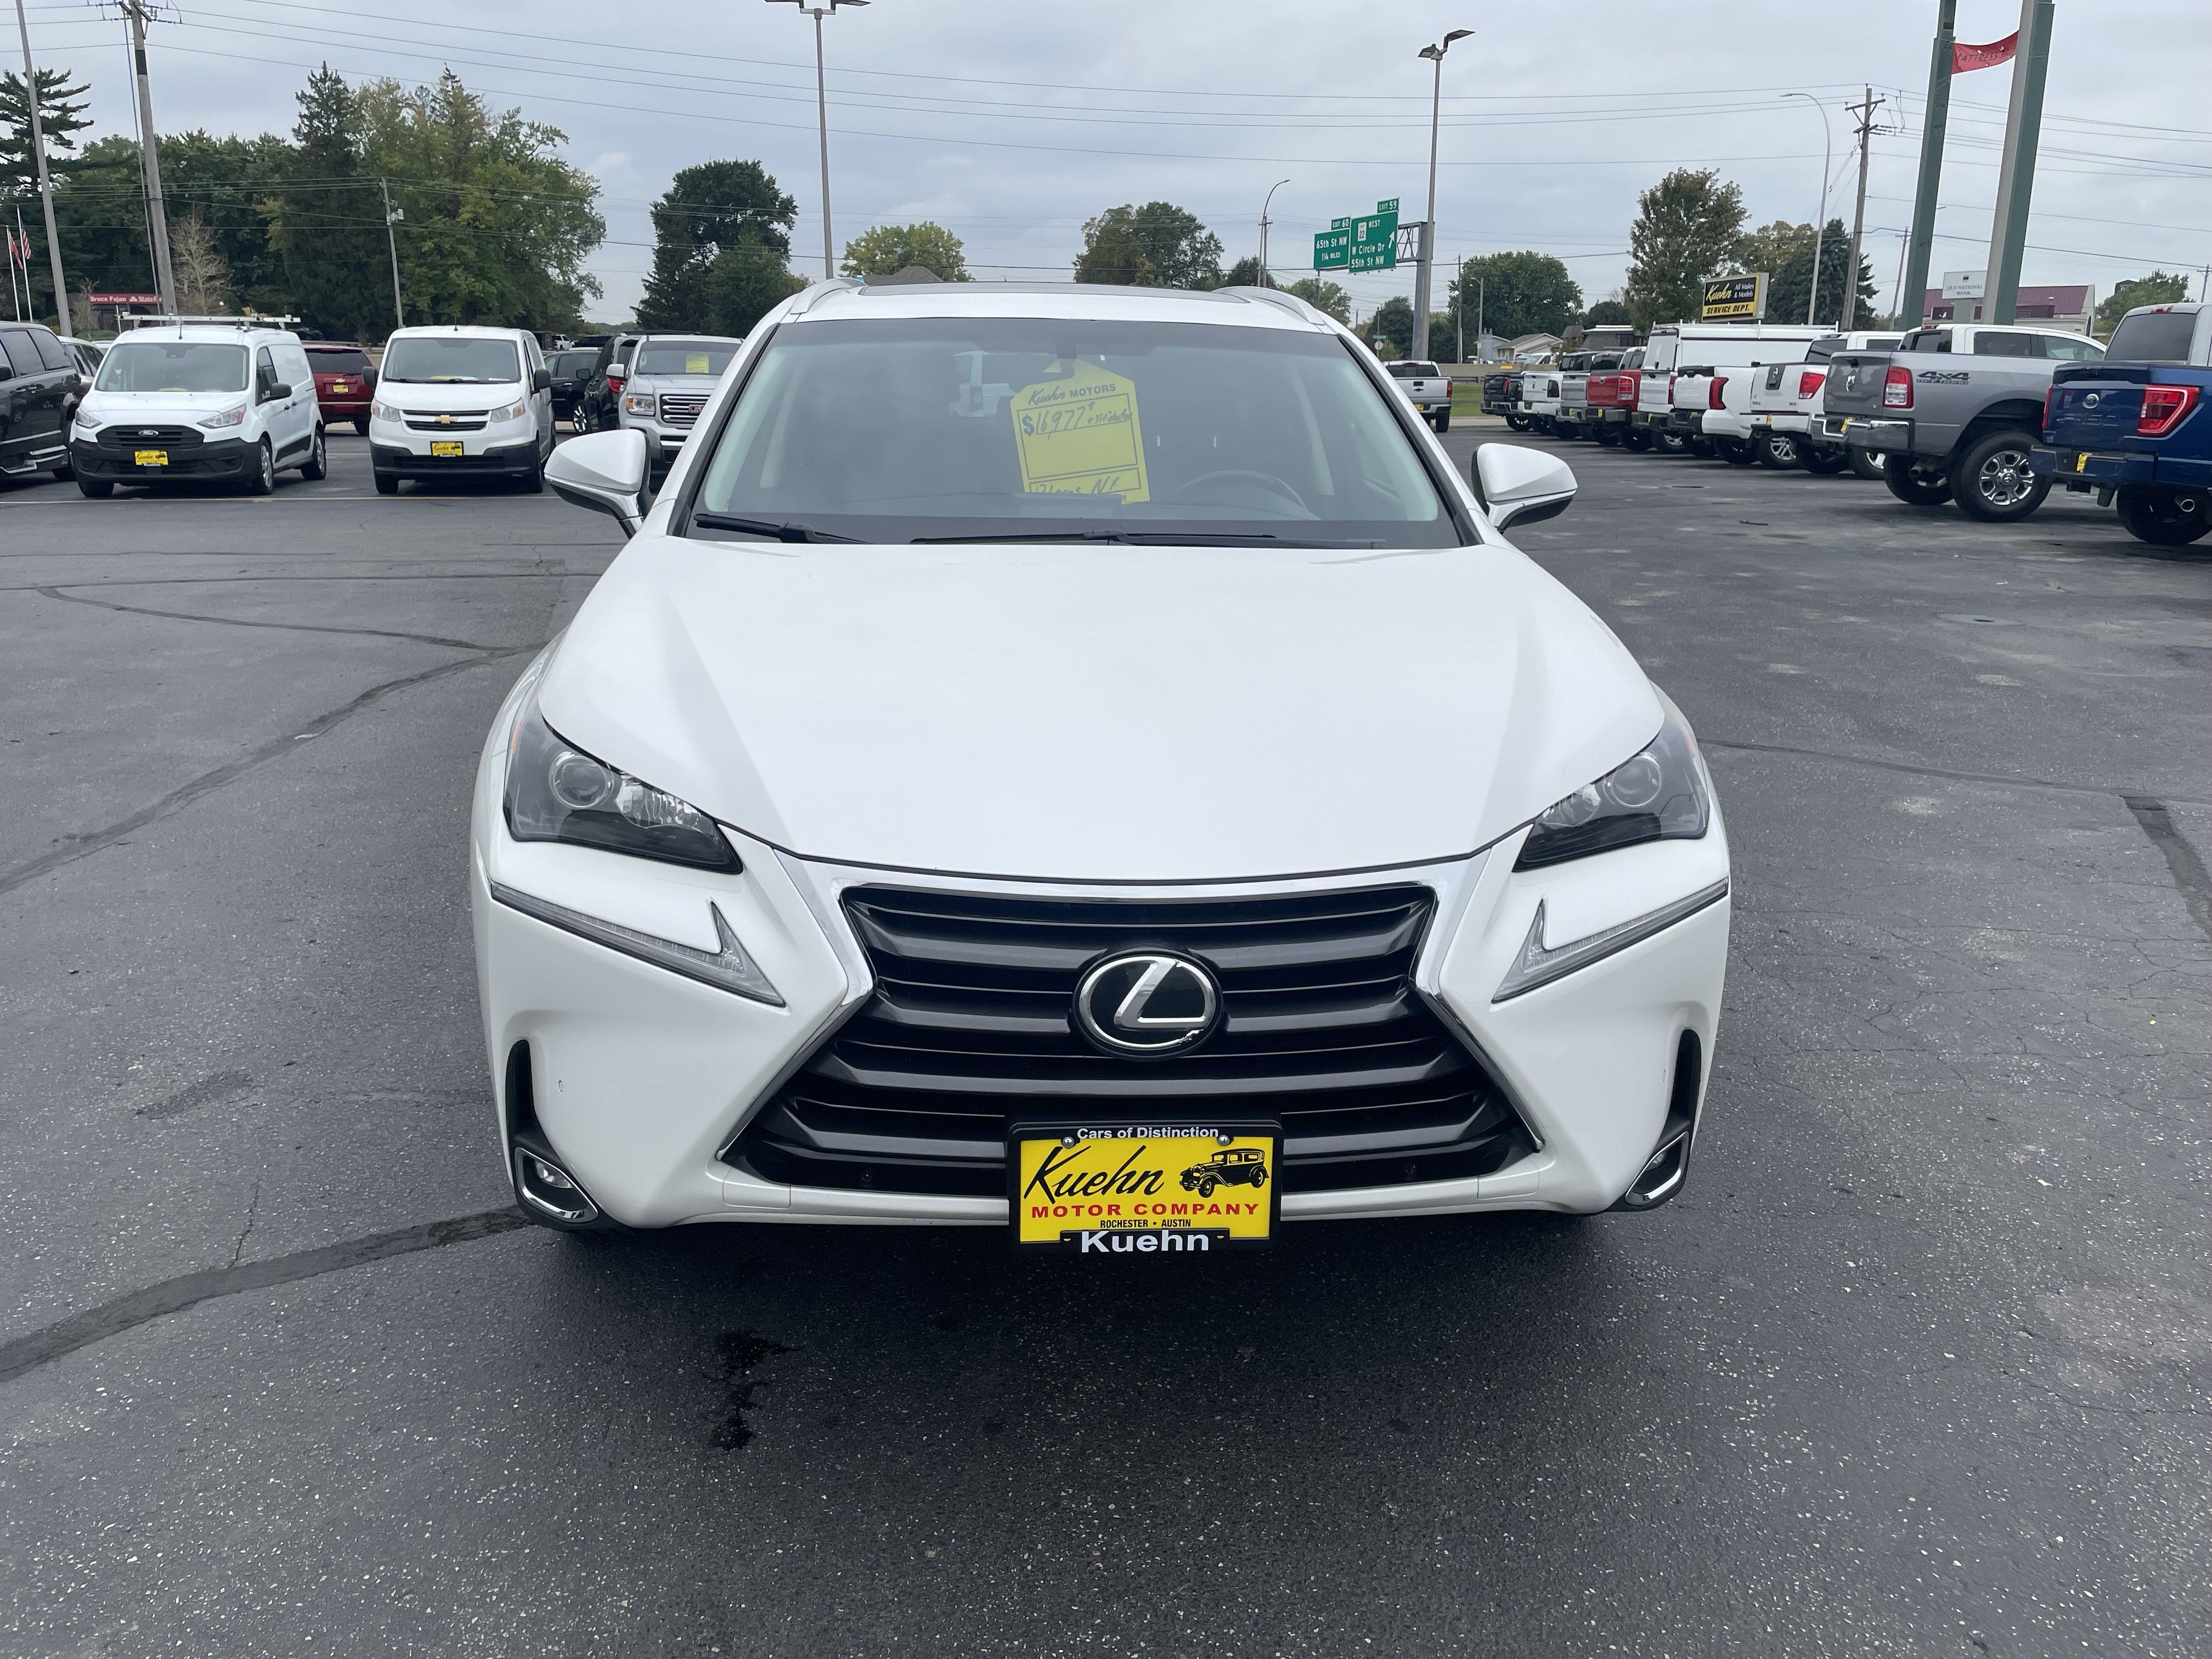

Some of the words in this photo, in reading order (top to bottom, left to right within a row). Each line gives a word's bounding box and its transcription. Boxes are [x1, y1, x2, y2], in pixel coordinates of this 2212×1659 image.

[1389, 200, 1397, 210] 59
[1342, 218, 1349, 227] 60
[1368, 219, 1380, 228] WEST
[1359, 230, 1365, 239] 22
[1317, 240, 1329, 249] 65th
[1331, 238, 1337, 247] St
[1339, 236, 1347, 246] NW
[1352, 246, 1357, 255] W
[1358, 244, 1375, 254] Circle
[1378, 242, 1385, 252] Dr
[1351, 258, 1364, 268] 55th
[1367, 257, 1373, 267] St
[1375, 255, 1384, 265] NW
[1706, 283, 1732, 303] Kuehn
[1707, 306, 1731, 315] SERVICE
[1029, 386, 1066, 405] Kuehn
[1070, 383, 1116, 398] MOTORS
[1077, 1128, 1113, 1139] Cars
[1118, 1127, 1133, 1138] of
[1137, 1127, 1219, 1138] Distinction
[1024, 1145, 1165, 1204] Kuehn
[1031, 1204, 1121, 1218] MOTOR
[1134, 1203, 1259, 1216] COMPANY
[1100, 1219, 1148, 1228] ROCHESTER
[1161, 1219, 1191, 1228] AUSTIN
[1081, 1229, 1209, 1253] Kuehn
